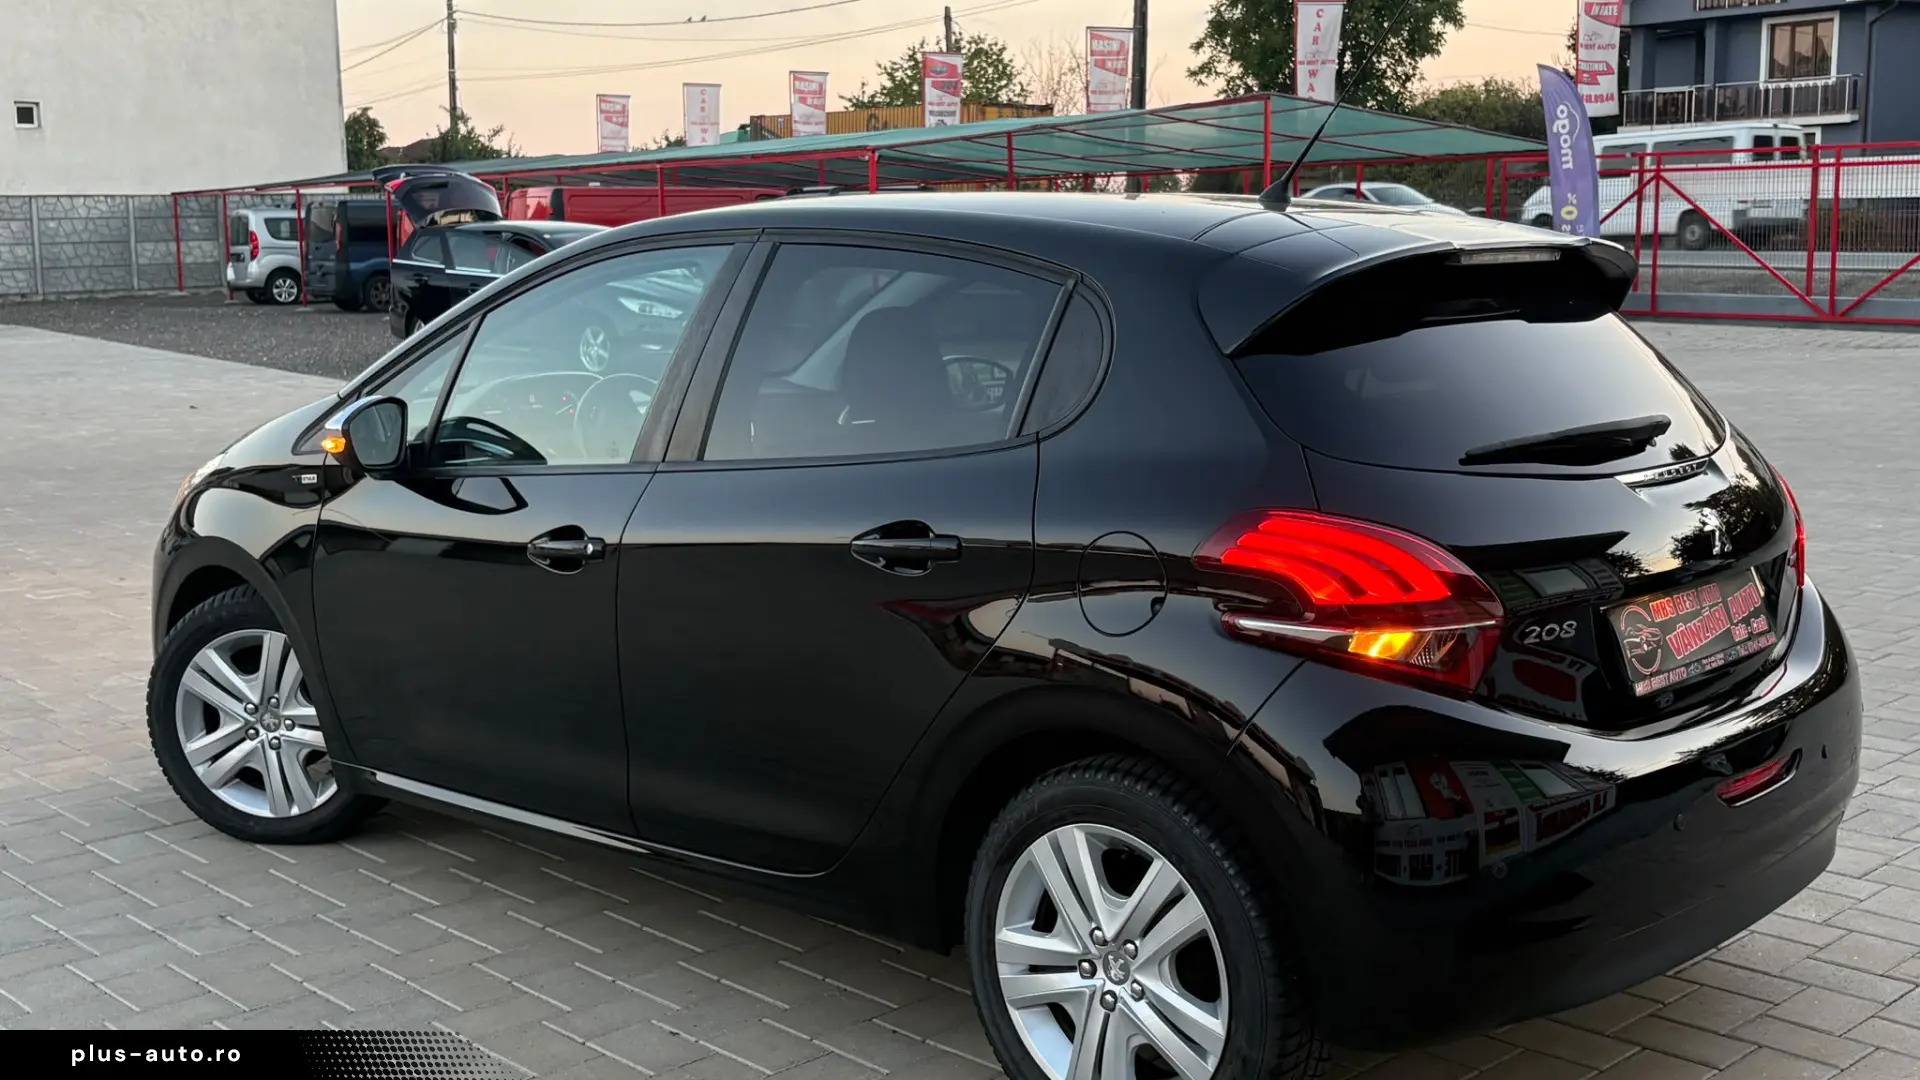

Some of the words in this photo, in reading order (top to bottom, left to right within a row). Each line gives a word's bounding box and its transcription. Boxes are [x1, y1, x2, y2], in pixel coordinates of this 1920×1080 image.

[1312, 8, 1324, 45] CAR
[1649, 597, 1676, 623] MBS
[1673, 589, 1700, 615] BEST
[1698, 583, 1722, 608] AUTO
[1666, 603, 1731, 660] VÂNZĂRI
[1727, 582, 1761, 623] AUTO
[1523, 620, 1578, 644] 208
[1669, 666, 1688, 684] AUTO
